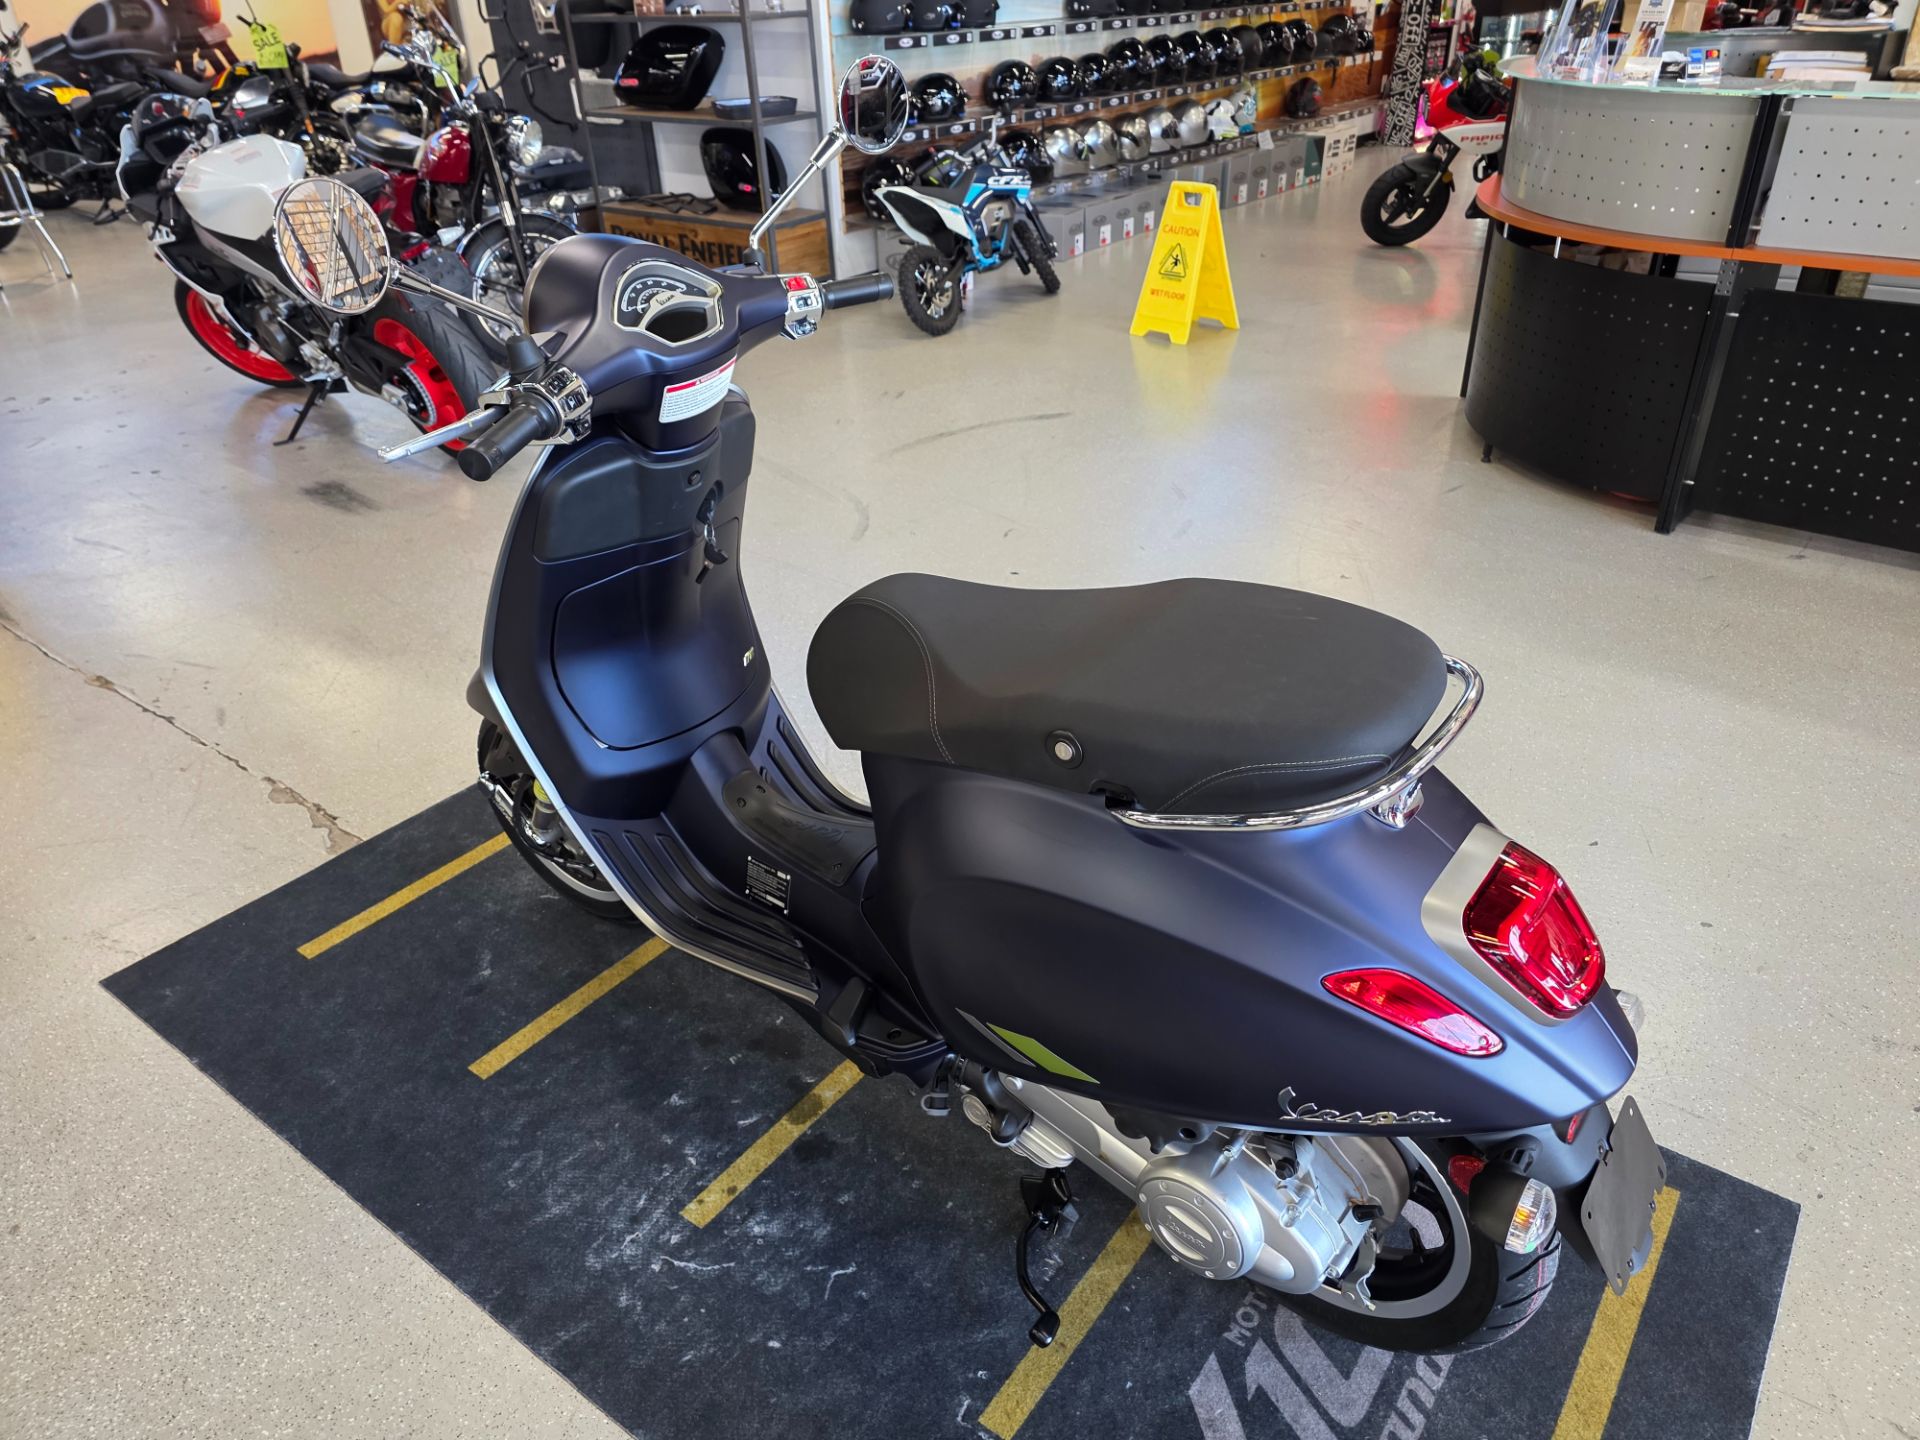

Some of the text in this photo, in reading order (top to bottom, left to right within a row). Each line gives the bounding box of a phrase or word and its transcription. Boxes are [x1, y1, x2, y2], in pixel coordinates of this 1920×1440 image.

[253, 31, 282, 52] SALE
[1162, 223, 1200, 238] CAUTION
[1277, 1086, 1452, 1126] Vespa
